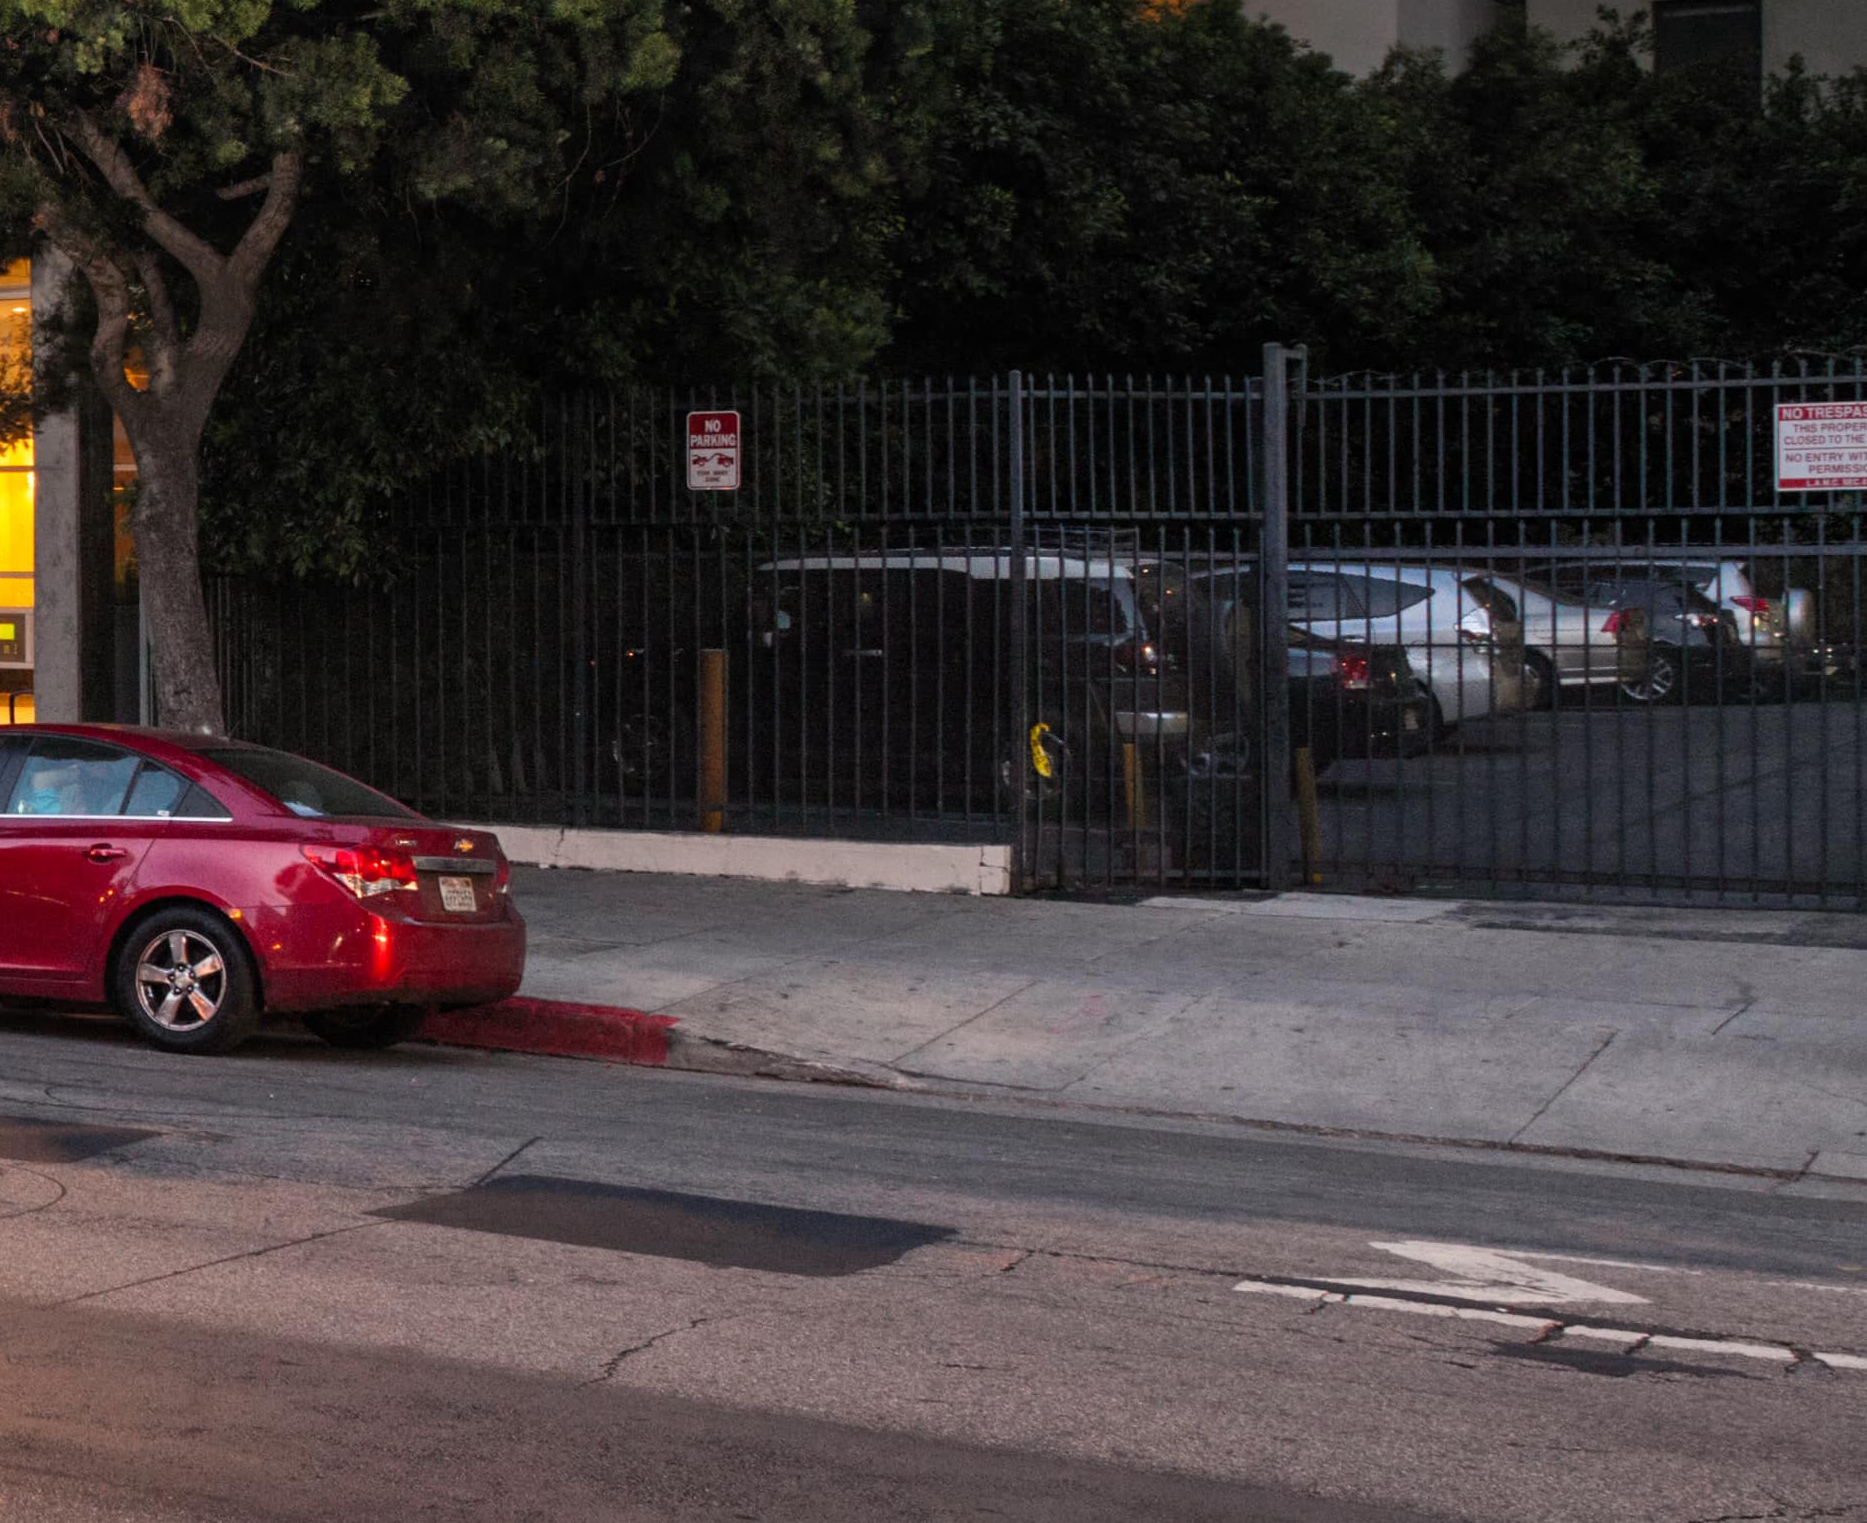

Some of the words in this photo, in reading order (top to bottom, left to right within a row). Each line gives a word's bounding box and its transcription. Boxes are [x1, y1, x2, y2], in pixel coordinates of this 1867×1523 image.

[1782, 408, 1804, 420] NO
[705, 419, 722, 432] NO
[1794, 423, 1818, 433] THIS
[691, 434, 736, 447] PARKING
[1784, 435, 1825, 445] CLOSED
[1828, 435, 1842, 444] TO
[1846, 434, 1865, 443] THE
[1785, 453, 1803, 463] NO
[1805, 452, 1844, 462] ENTRY
